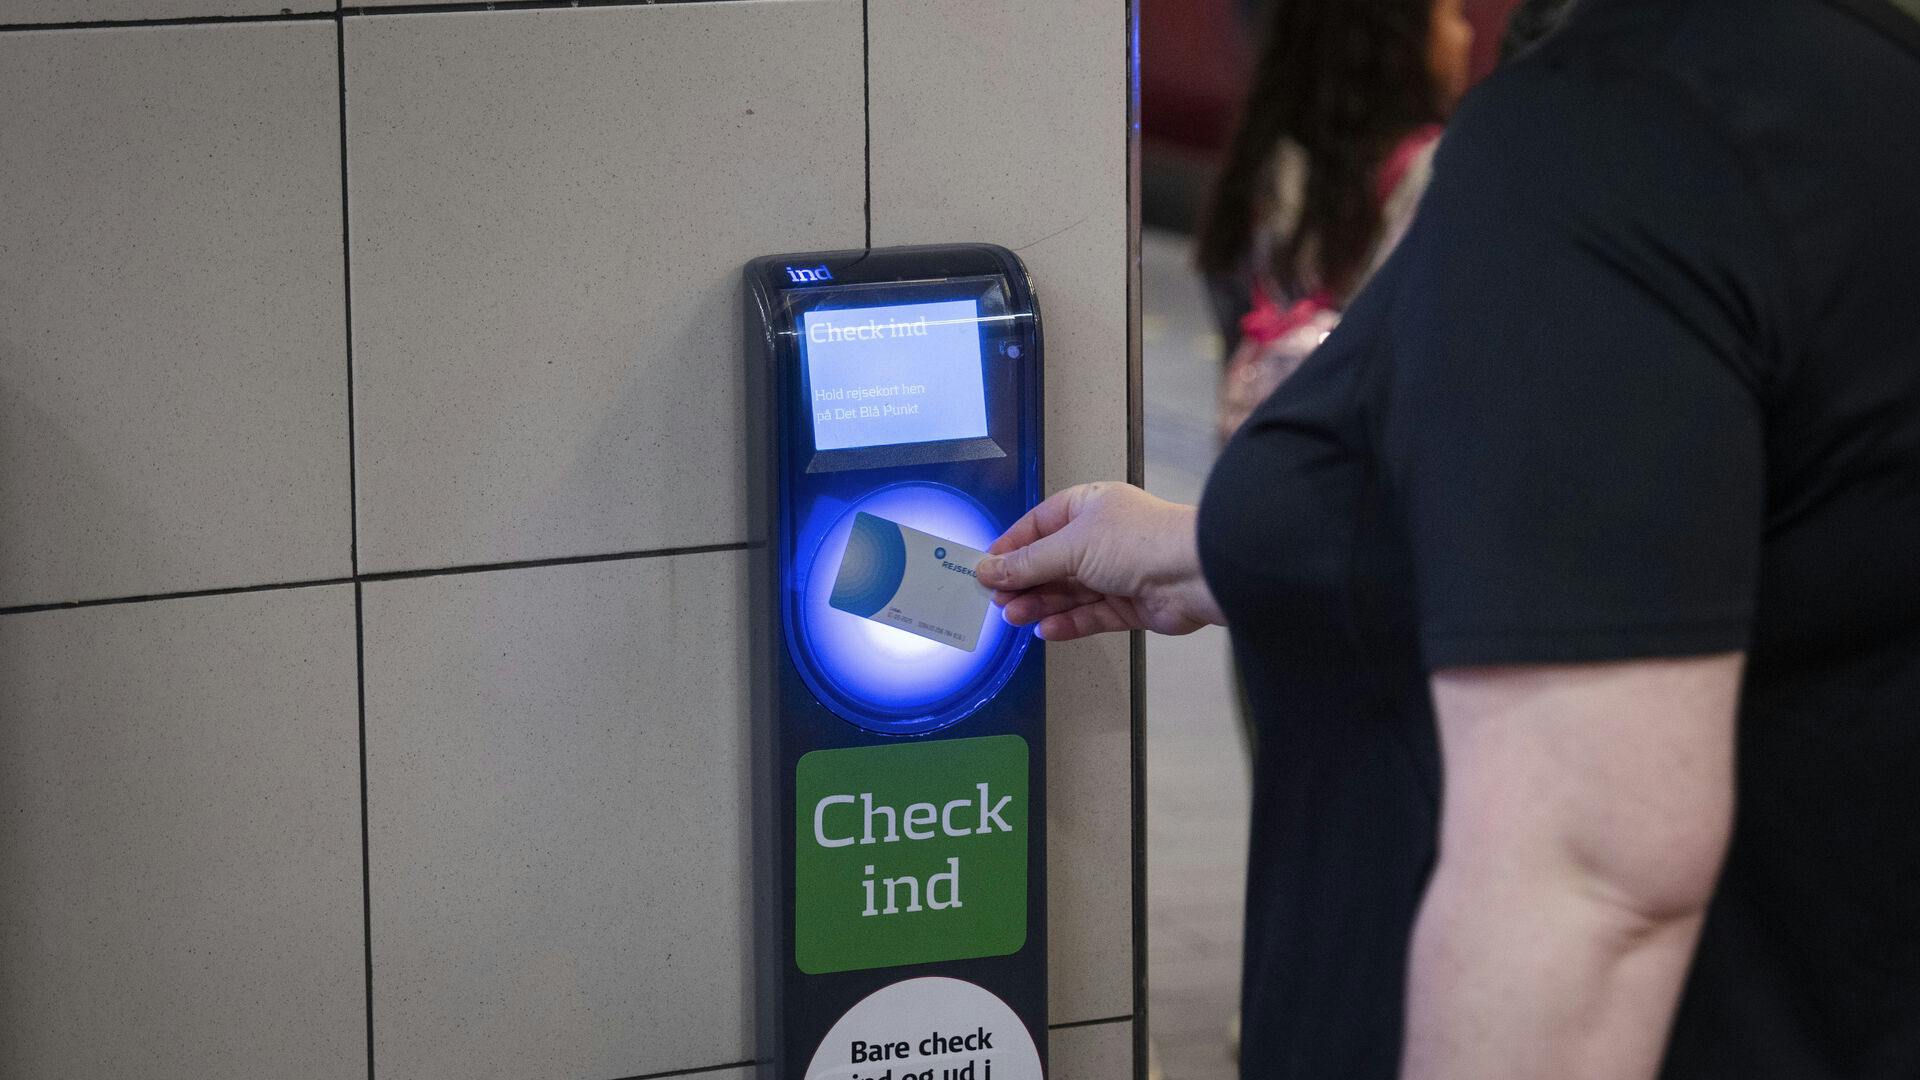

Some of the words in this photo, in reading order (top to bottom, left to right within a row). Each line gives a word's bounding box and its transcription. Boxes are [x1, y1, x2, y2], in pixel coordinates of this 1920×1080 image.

[786, 264, 833, 282] ind
[809, 319, 884, 344] Check
[890, 316, 929, 338] ind
[815, 387, 844, 401] Hold
[846, 384, 899, 401] rejsekort
[902, 383, 926, 395] hen
[816, 408, 833, 424] på
[834, 407, 858, 421] Det
[859, 405, 881, 419] Blå
[882, 402, 920, 417] Punkt
[813, 782, 1013, 849] Check
[861, 856, 963, 917] ind
[851, 1040, 910, 1064] Bare
[918, 1026, 994, 1056] check
